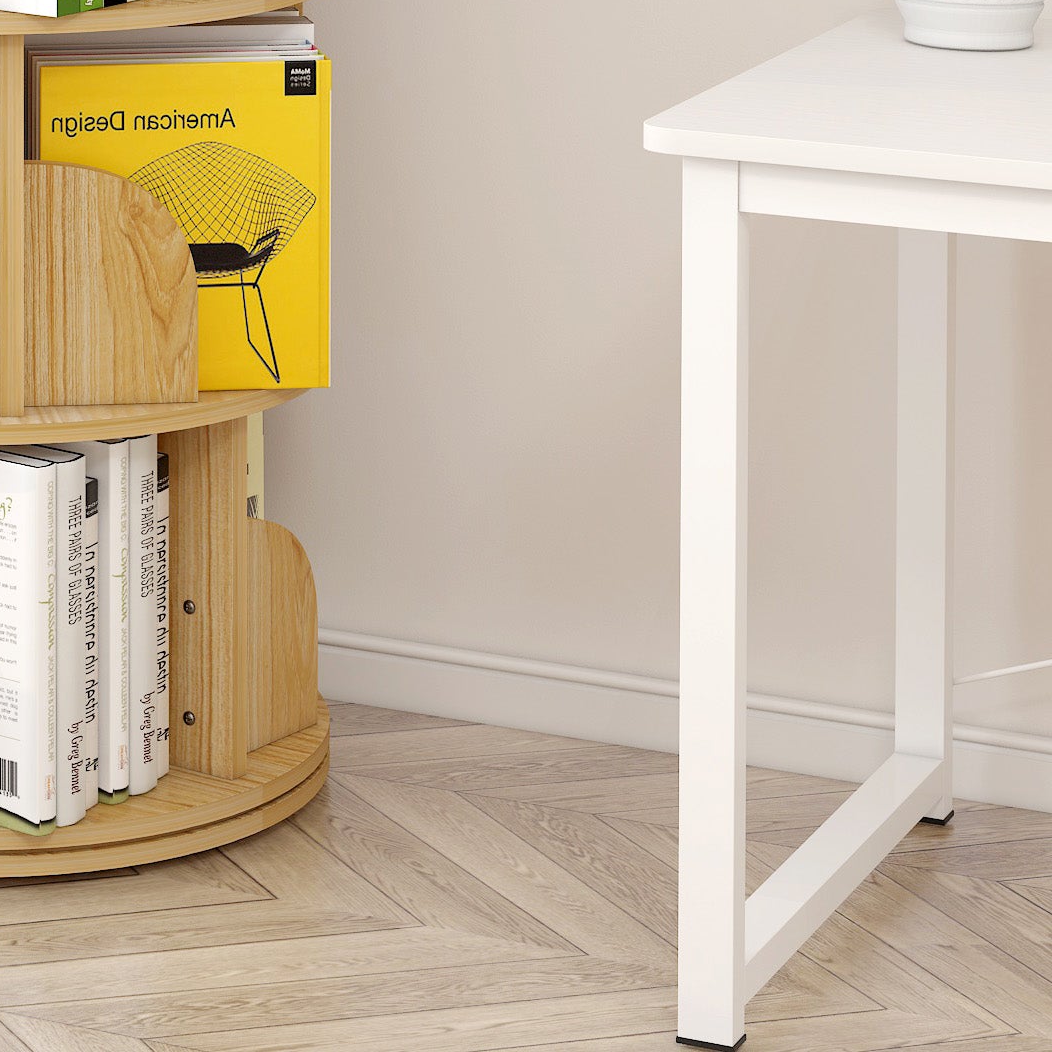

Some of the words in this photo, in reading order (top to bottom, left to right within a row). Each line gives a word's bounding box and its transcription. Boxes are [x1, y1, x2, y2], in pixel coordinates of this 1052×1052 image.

[141, 471, 154, 504] THREE
[68, 495, 82, 530] THREE
[141, 507, 154, 535] PAIRS
[68, 533, 82, 561] PAIRS
[141, 537, 154, 551] OF
[68, 564, 82, 578] OF
[141, 555, 154, 598] GLASSES
[68, 581, 82, 625] GLASSES
[140, 691, 155, 705] by
[68, 720, 83, 734] by
[140, 706, 155, 730] Greg
[68, 736, 82, 760] Greg
[143, 732, 155, 765] Bennet
[71, 761, 83, 795] Bennet
